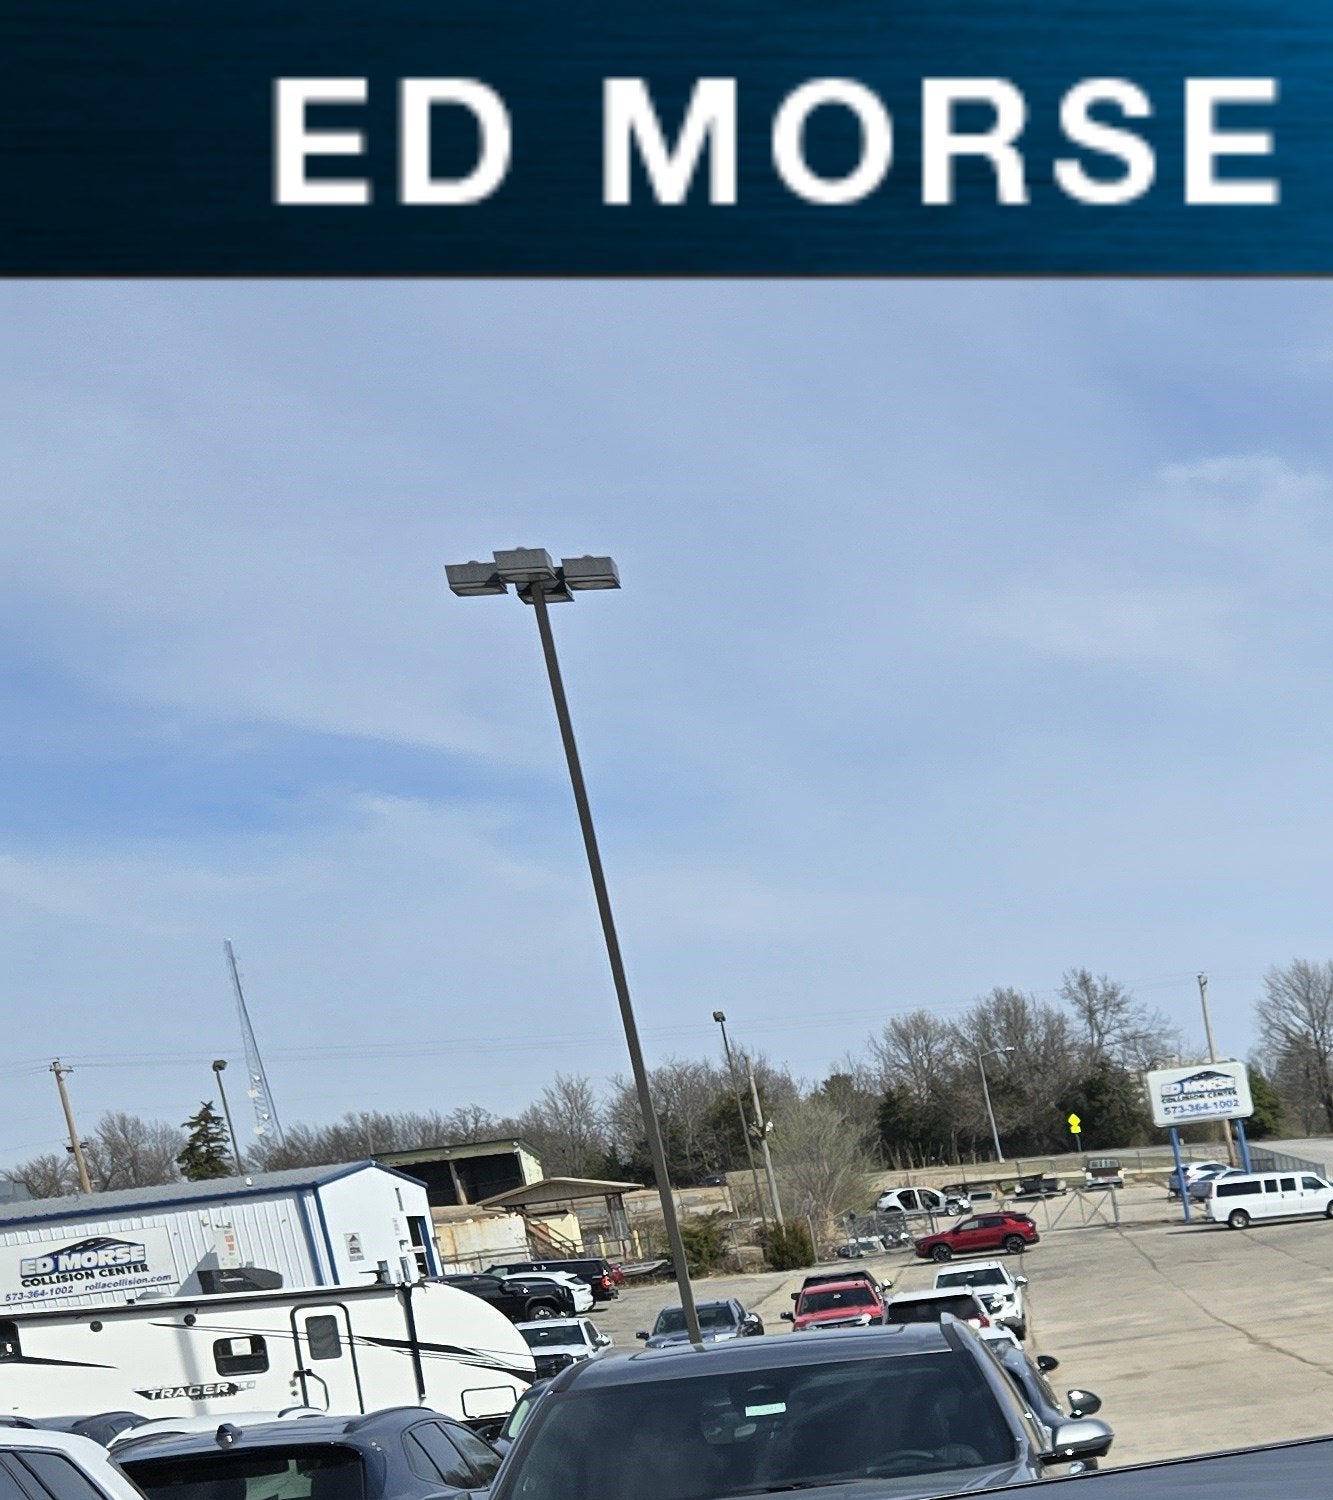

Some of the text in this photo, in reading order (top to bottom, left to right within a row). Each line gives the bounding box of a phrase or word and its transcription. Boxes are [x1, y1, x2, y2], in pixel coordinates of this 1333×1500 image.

[21, 1244, 145, 1277] ED MORSE
[5, 1274, 172, 1302] 573-364-1002 rollacollision.com
[21, 1263, 150, 1288] COLLISION CENTER
[148, 1383, 230, 1400] TRACER
